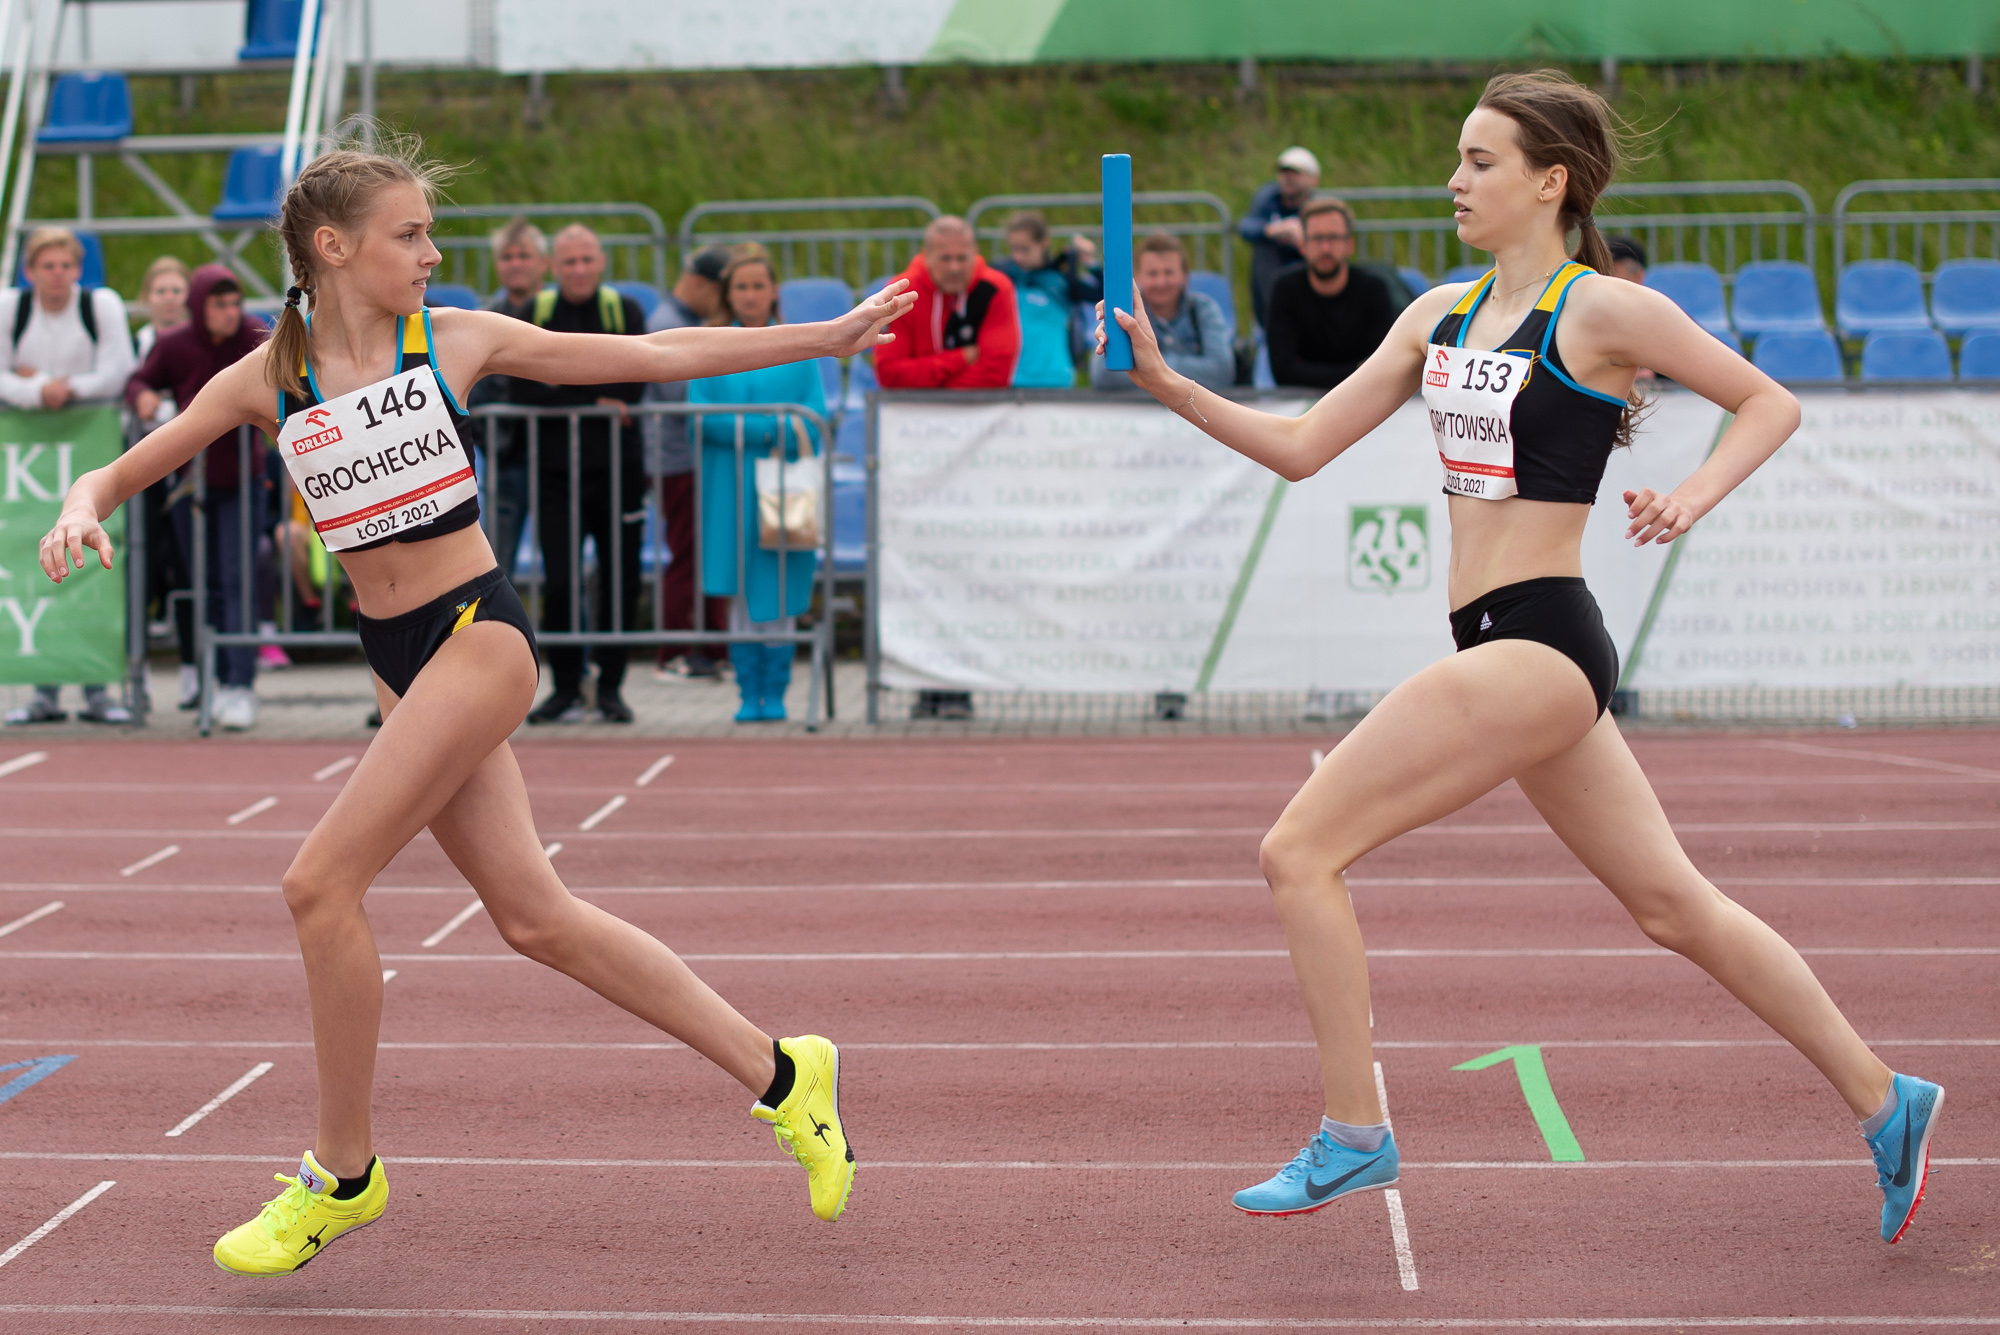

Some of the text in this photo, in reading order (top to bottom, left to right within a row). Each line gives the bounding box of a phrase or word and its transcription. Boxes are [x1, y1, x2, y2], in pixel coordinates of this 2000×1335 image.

[1462, 358, 1513, 393] 153
[356, 377, 427, 430] 146
[294, 428, 340, 454] ORLEN
[1907, 440, 1978, 461] SPORT
[304, 428, 456, 500] GROCHECKA
[968, 449, 1098, 469] ATMOSFERA
[1113, 449, 1203, 469] ZABAWA
[1, 442, 76, 501] KI
[1446, 470, 1486, 494] ÓDŹ 2021
[994, 487, 1084, 506] ZABAWA
[1107, 487, 1181, 506] SPORT
[1777, 479, 1850, 499] SPORT
[1863, 478, 1994, 499] ATMOSFERA
[356, 499, 440, 541] ŁÓDŹ 2021
[913, 519, 1044, 539] ATMOSFERA
[1058, 519, 1148, 538] ZABAWA
[1748, 511, 1838, 532] ZABAWA
[1852, 510, 1924, 531] SPORT
[904, 551, 1224, 572] SPORT ATMOSFERA ZABAWA
[1800, 543, 1889, 563] ZABAWA
[1898, 541, 1973, 561] SPORT
[966, 583, 1038, 603] SPORT
[1053, 583, 1185, 602] ATMOSFERA
[1734, 578, 1866, 599] ATMOSFERA
[1881, 575, 1973, 596] ZABAWA
[934, 621, 1065, 641] ATMOSFERA
[1078, 621, 1170, 641] ZABAWA
[1744, 611, 1835, 634] ZABAWA
[1852, 609, 1925, 633] SPORT
[1002, 652, 1131, 671] ATMOSFERA
[1677, 648, 1808, 669] ATMOSFERA
[1821, 644, 1914, 666] ZABAWA
